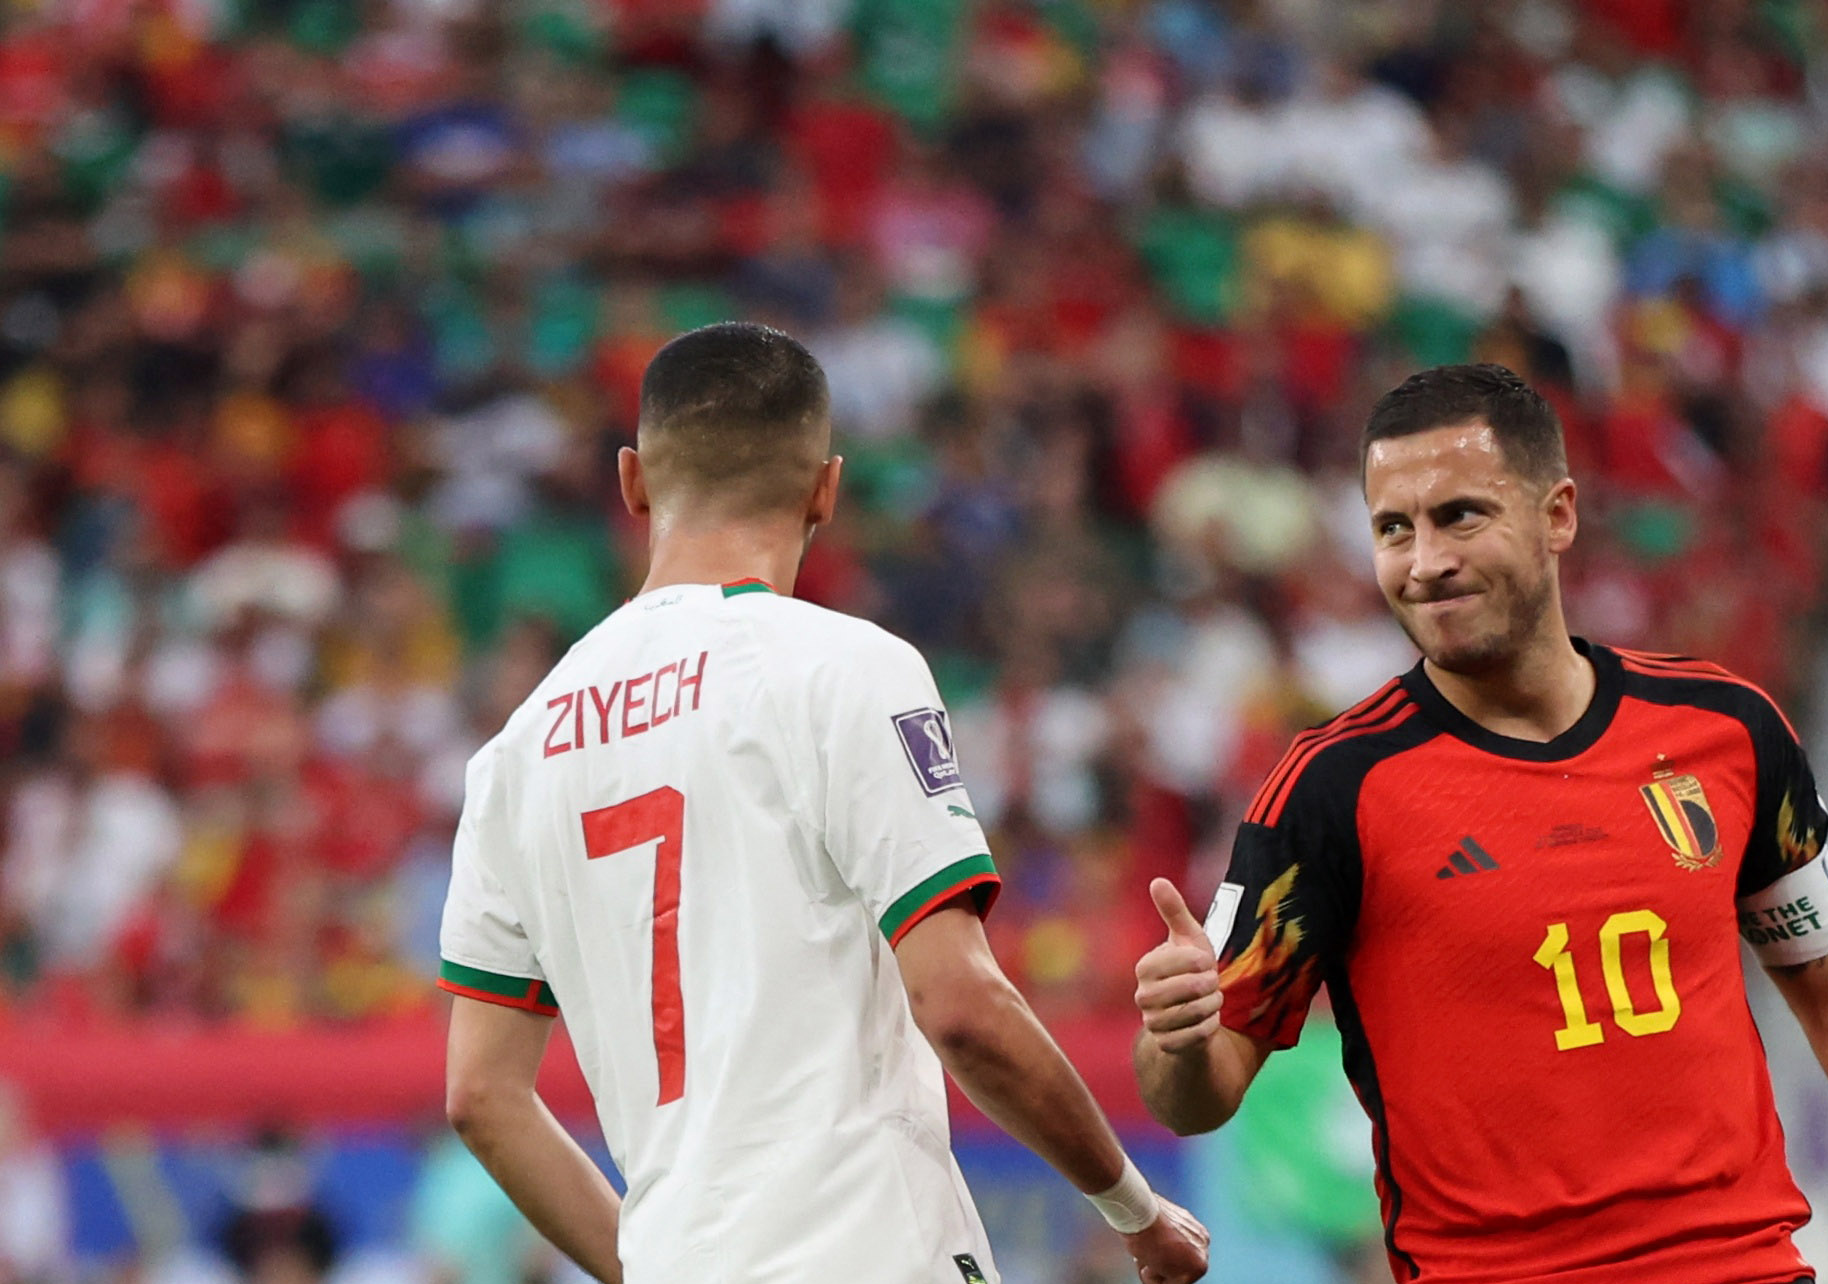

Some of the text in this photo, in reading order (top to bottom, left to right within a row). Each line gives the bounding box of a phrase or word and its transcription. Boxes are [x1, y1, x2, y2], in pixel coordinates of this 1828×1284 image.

[543, 650, 708, 760] ZIYECH
[581, 784, 686, 1107] 7
[1762, 896, 1815, 923] THE
[1532, 909, 1682, 1051] 10
